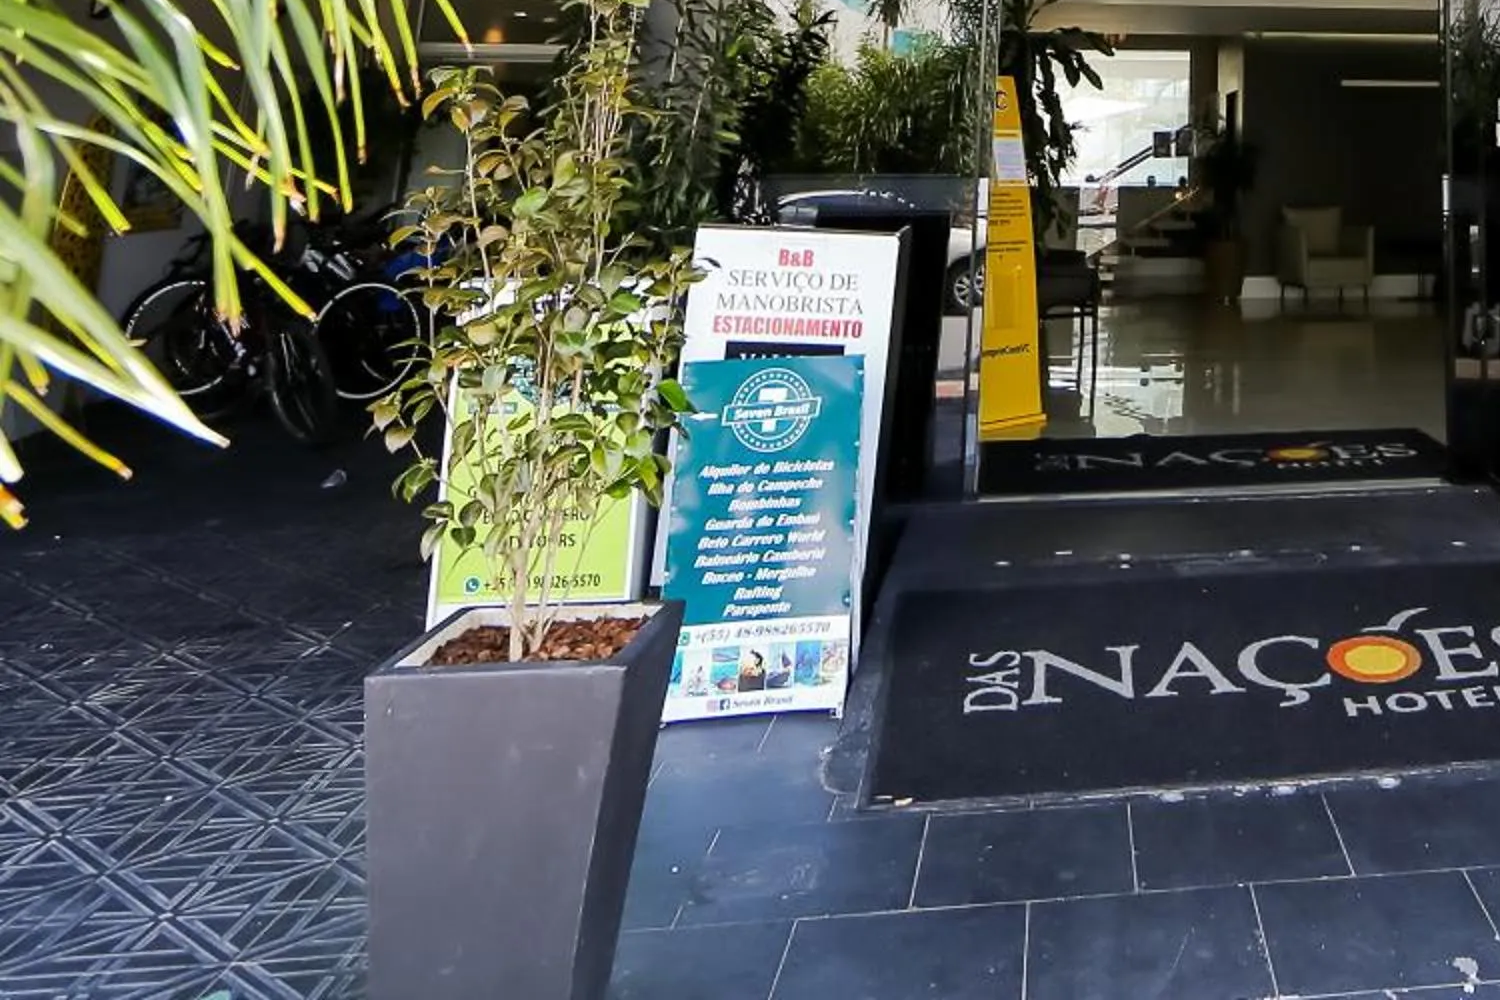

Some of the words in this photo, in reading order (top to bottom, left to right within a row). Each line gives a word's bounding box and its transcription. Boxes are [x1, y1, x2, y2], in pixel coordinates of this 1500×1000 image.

[778, 248, 814, 267] B&B
[727, 269, 823, 293] SERVIÇO
[829, 273, 859, 291] DE
[716, 293, 863, 315] MANOBRISTA
[712, 314, 863, 339] ESTACIONAMENTO
[787, 529, 826, 543] World
[963, 650, 1022, 714] DAS
